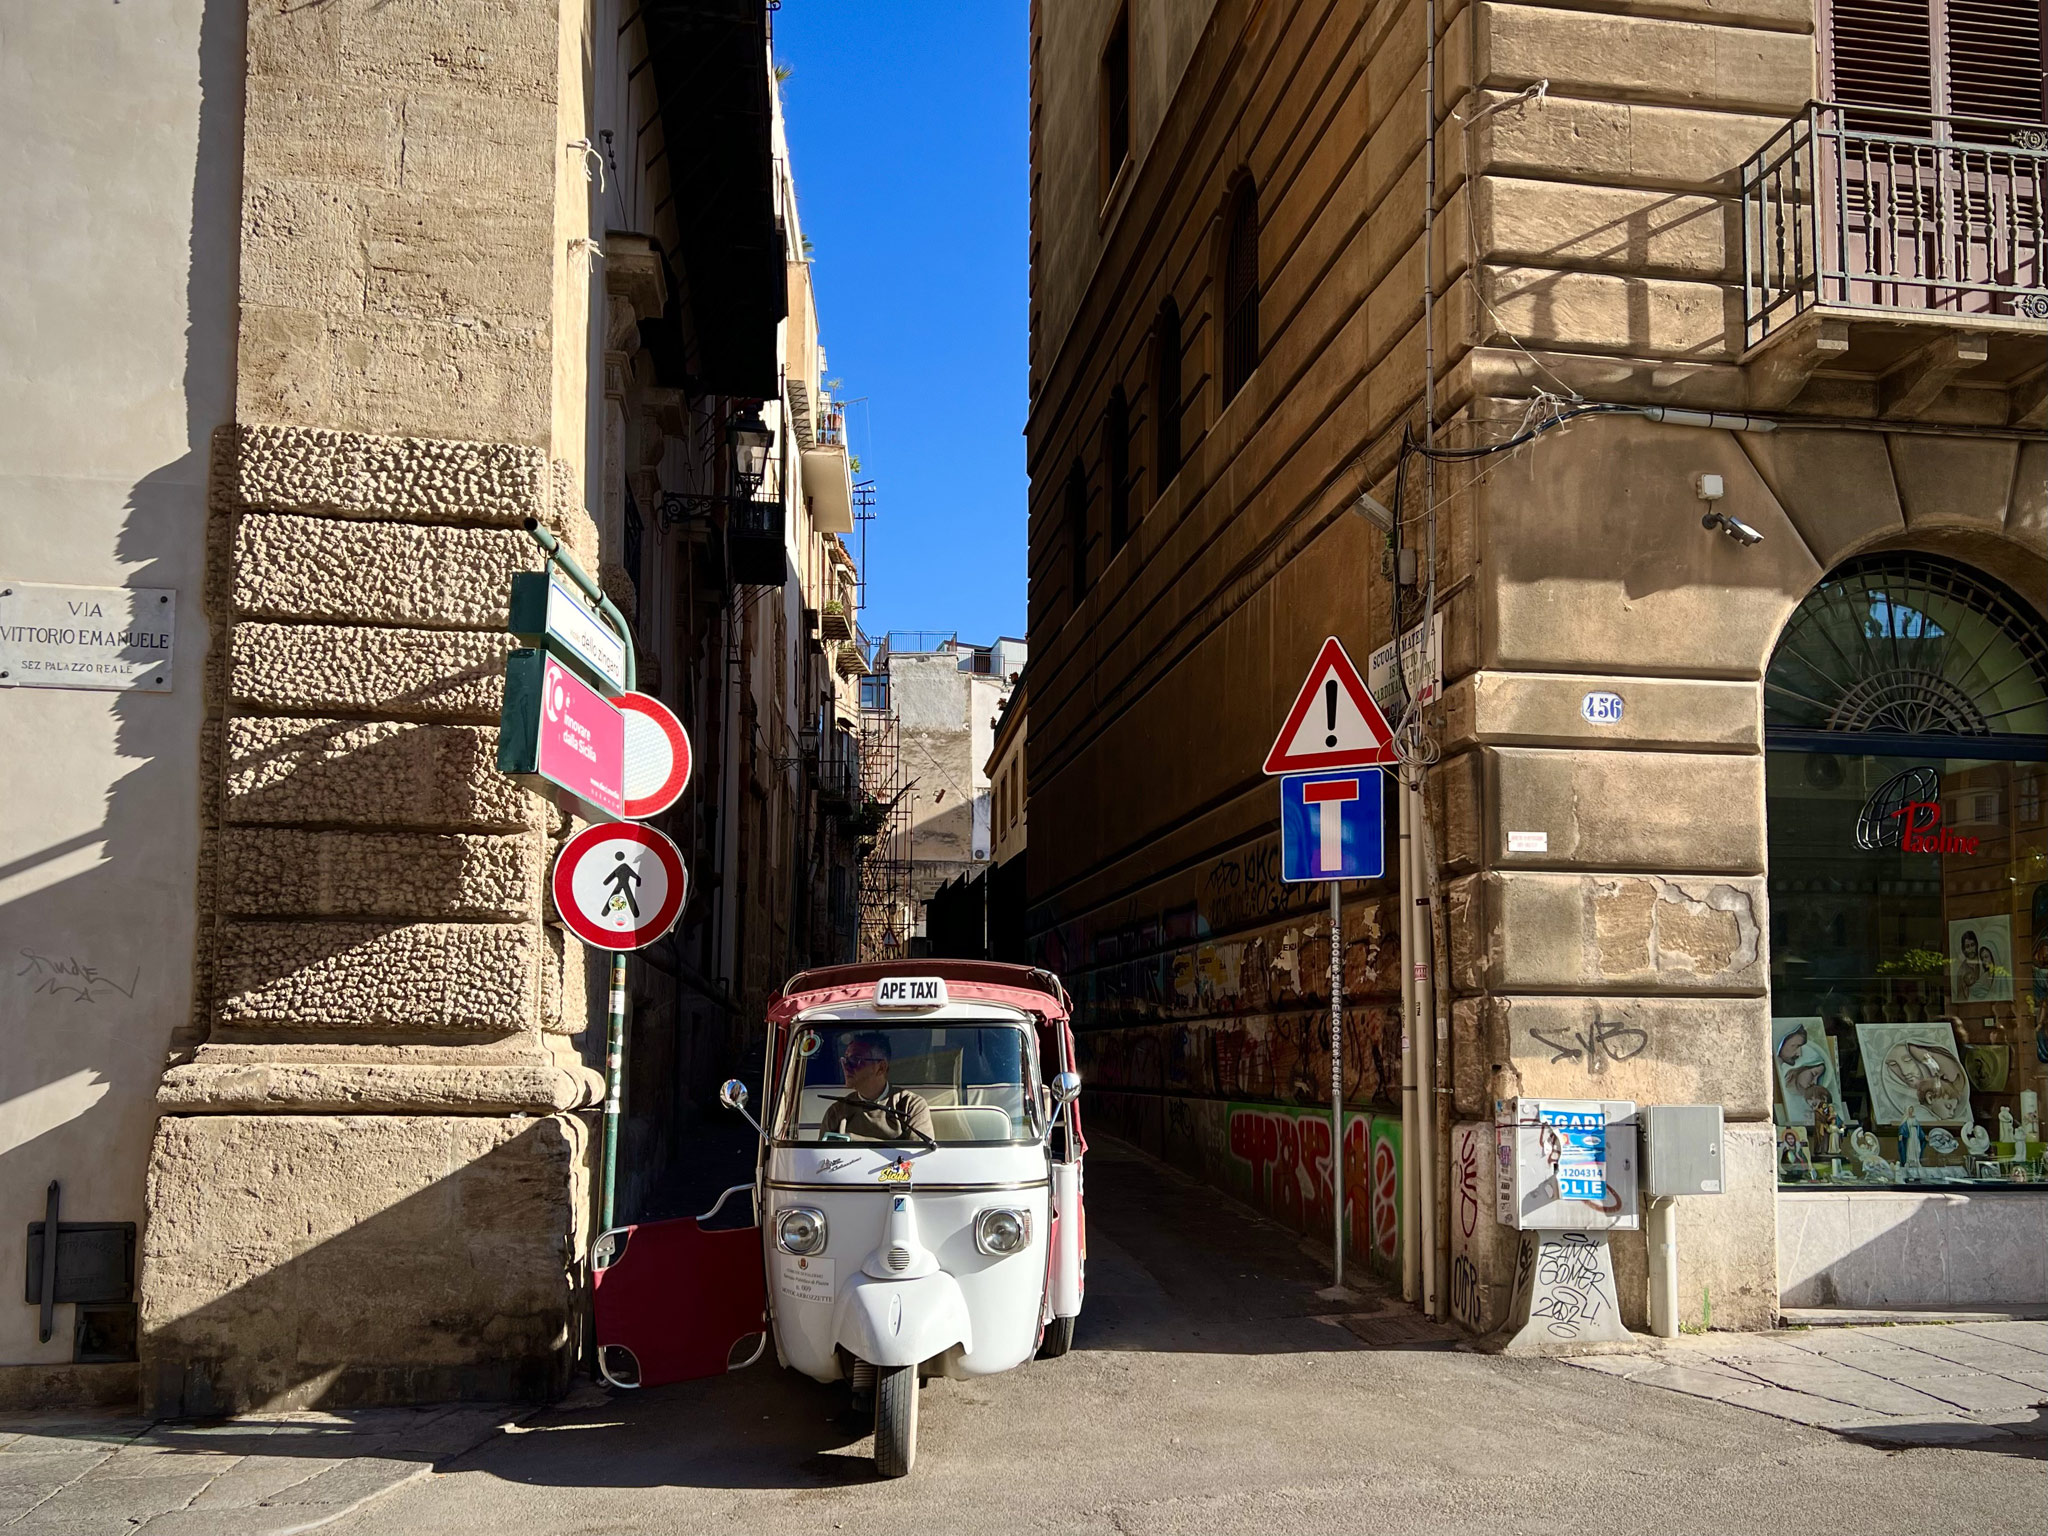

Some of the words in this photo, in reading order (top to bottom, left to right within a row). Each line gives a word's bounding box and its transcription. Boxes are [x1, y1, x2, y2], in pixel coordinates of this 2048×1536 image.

[68, 601, 103, 617] VIA
[0, 626, 75, 646] VITTORIO
[79, 630, 169, 649] EMANUELE
[21, 660, 41, 670] SEZ
[45, 661, 93, 672] PALAZZO
[96, 663, 133, 674] REALE
[1585, 697, 1622, 720] 456
[564, 709, 591, 742] innovare
[562, 730, 579, 752] dalla
[578, 739, 597, 764] Sicilia
[1890, 800, 1980, 856] Paoline
[880, 982, 906, 999] APE
[910, 981, 937, 999] TAXI
